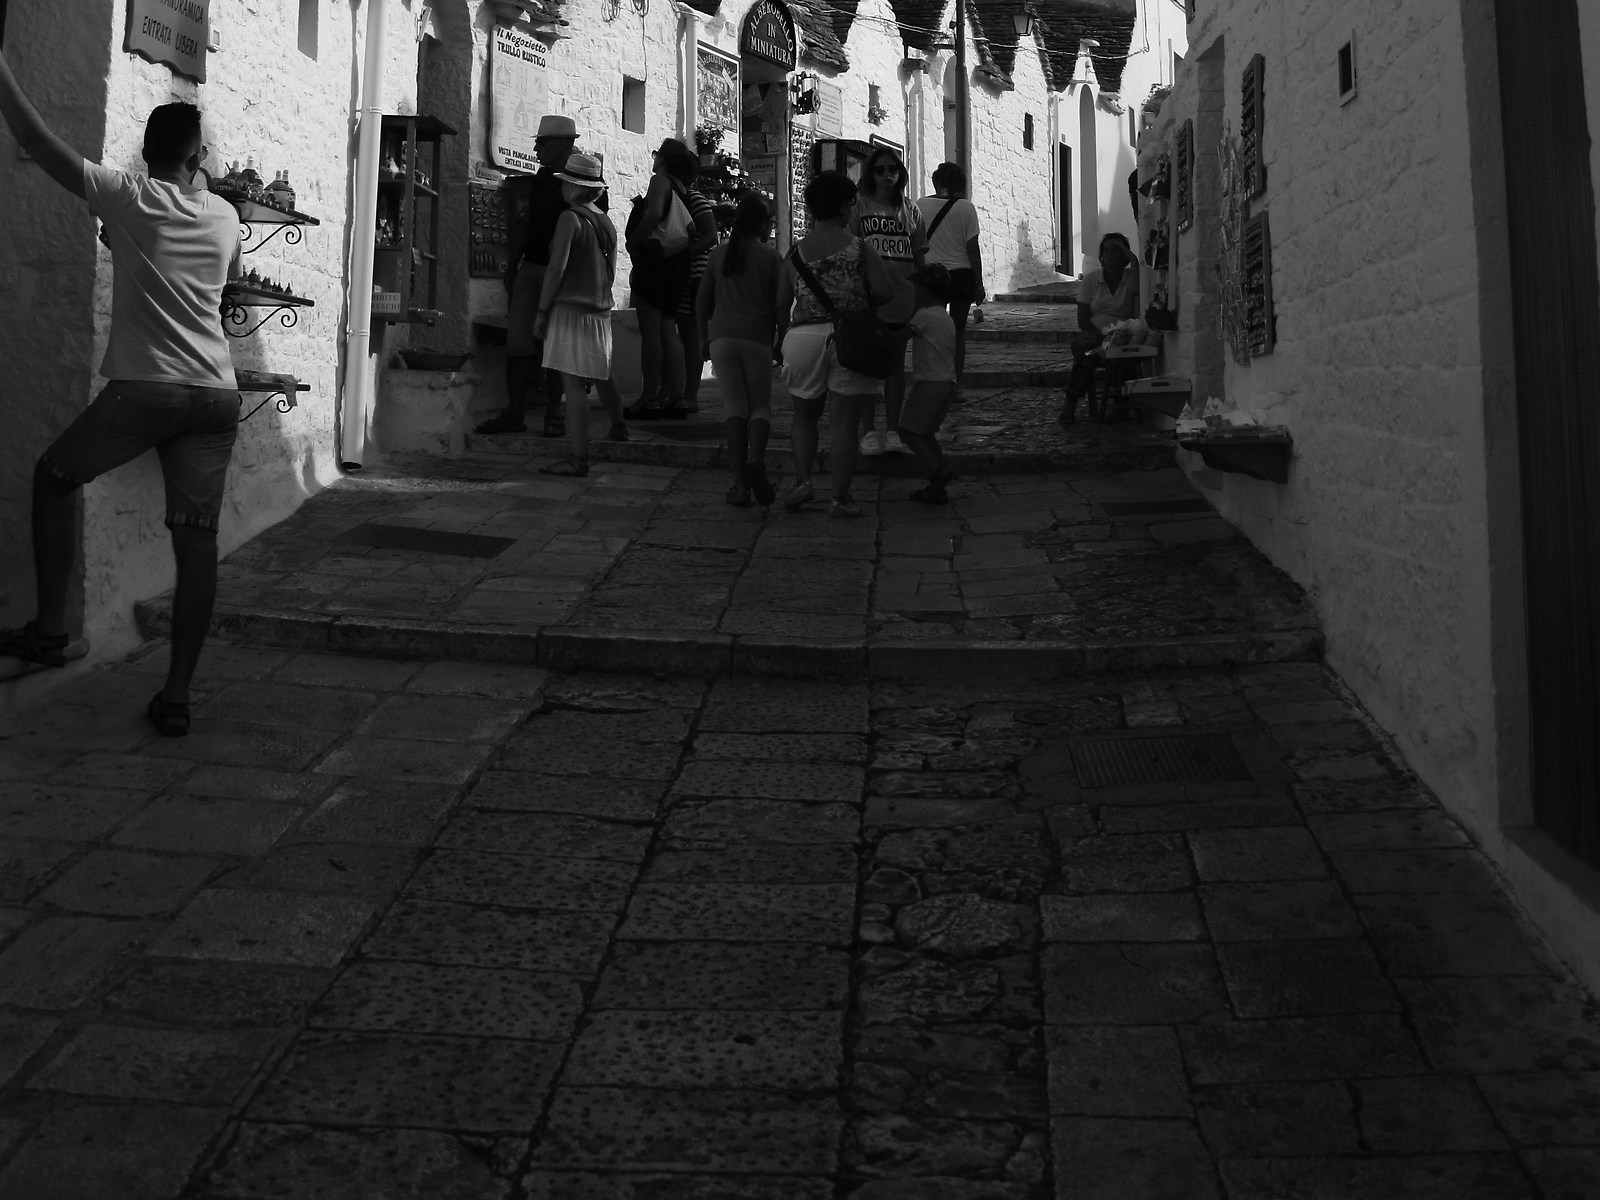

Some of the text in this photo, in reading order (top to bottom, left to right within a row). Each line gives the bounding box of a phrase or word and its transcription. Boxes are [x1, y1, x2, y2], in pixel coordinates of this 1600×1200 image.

[750, 1, 793, 52] ALBEROBELLO
[767, 23, 776, 39] IN
[142, 16, 198, 59] ENTRATA LIBERA
[505, 32, 546, 53] Negozietto
[497, 41, 546, 68] TRULLO RUSTICO
[750, 37, 792, 66] MINIATURA
[498, 146, 511, 156] VISTA
[505, 157, 536, 171] ENTRATA LIBERA
[863, 217, 879, 232] NO
